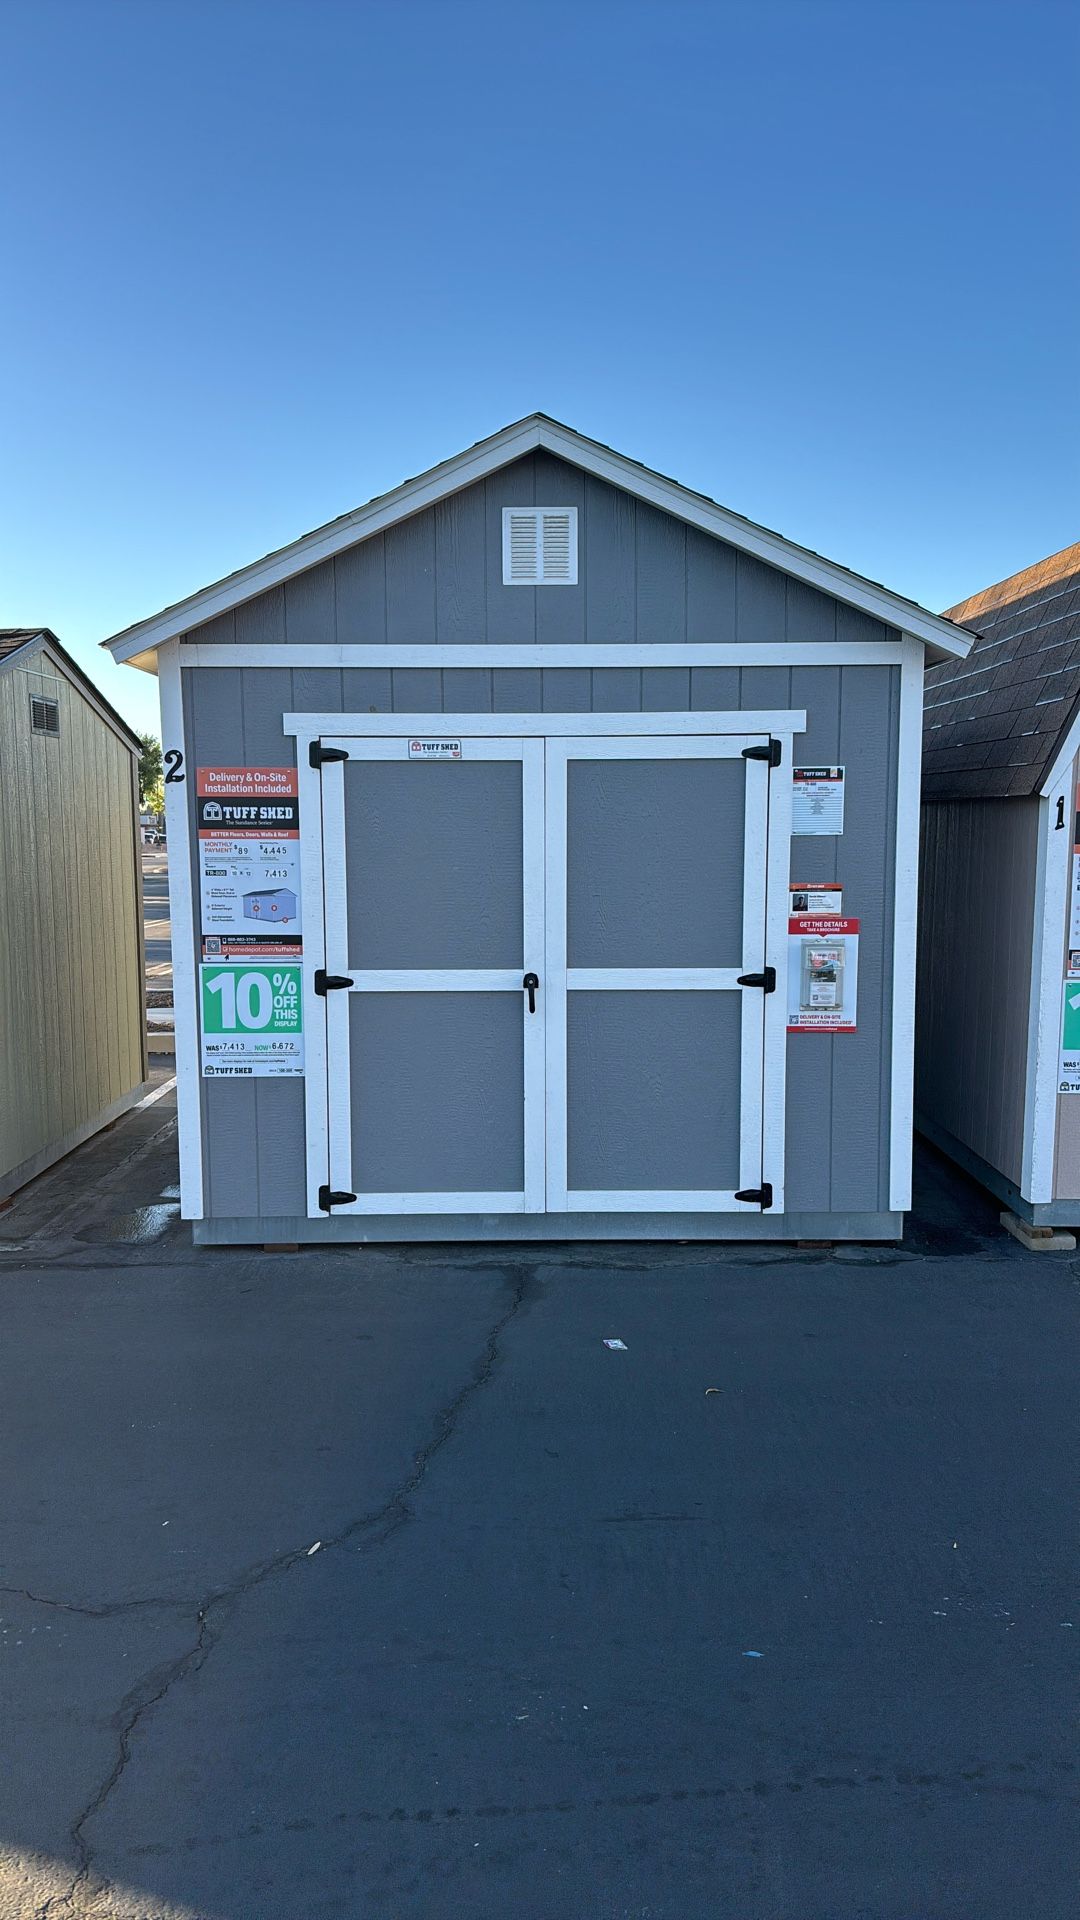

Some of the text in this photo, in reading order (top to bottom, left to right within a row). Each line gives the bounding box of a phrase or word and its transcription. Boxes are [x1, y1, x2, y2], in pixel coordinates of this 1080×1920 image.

[165, 750, 185, 784] 2
[209, 772, 287, 783] Delivery & On-Site
[205, 784, 292, 793] Installation Included
[223, 806, 294, 820] TUFF SHED
[1055, 796, 1065, 830] 1
[273, 995, 298, 1009] OFF
[273, 1009, 298, 1020] THIS
